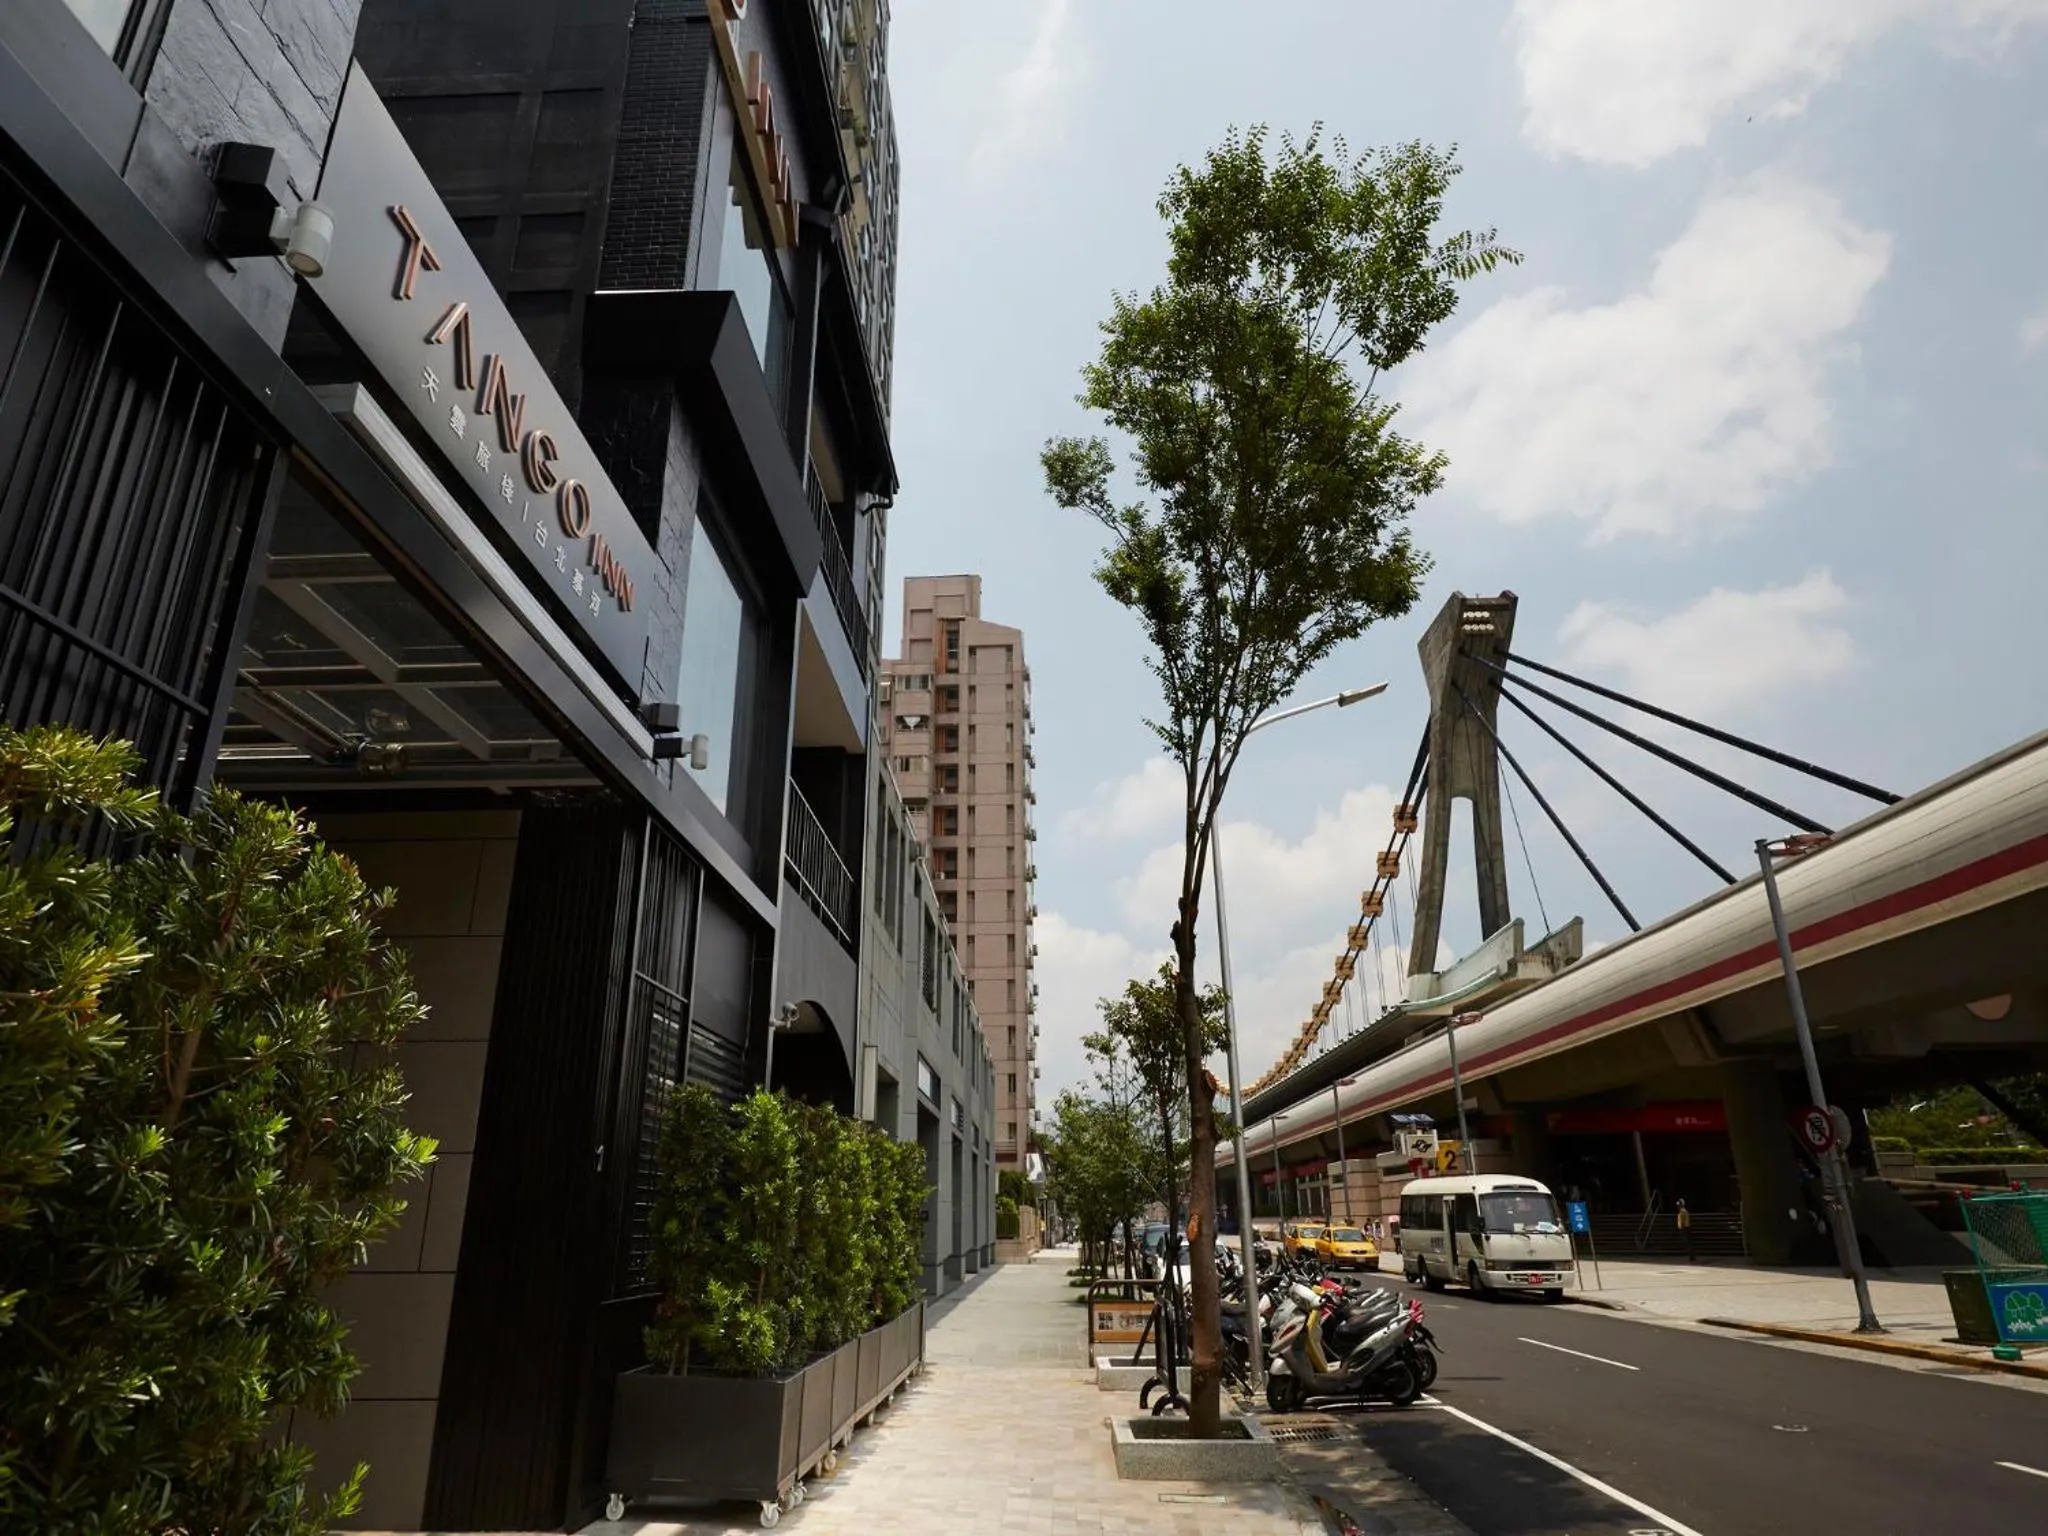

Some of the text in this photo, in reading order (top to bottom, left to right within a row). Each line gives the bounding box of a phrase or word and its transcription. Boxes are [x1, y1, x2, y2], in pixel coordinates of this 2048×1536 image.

[387, 204, 635, 612] TANGO INN
[1444, 1150, 1458, 1170] 2
